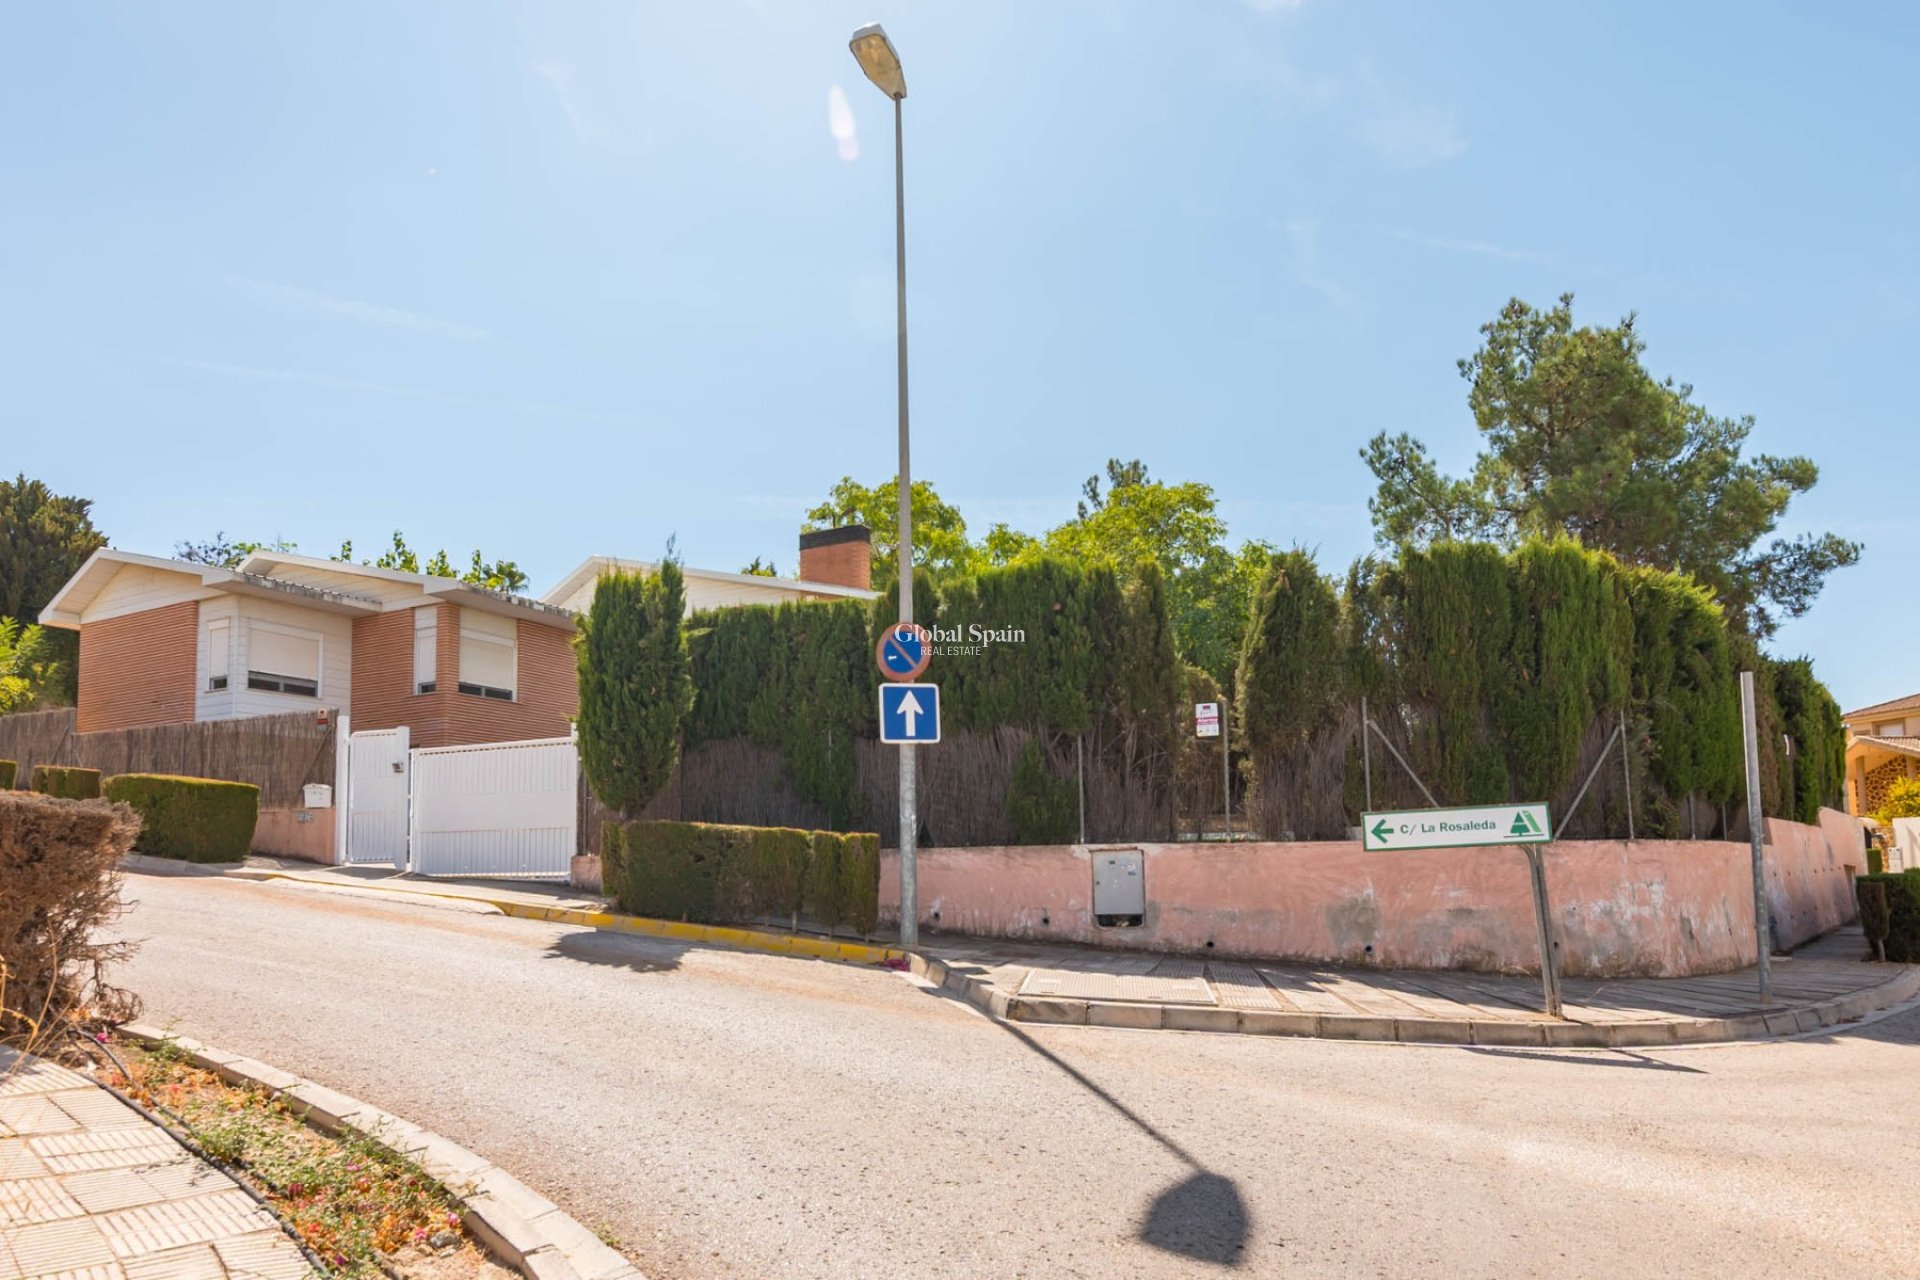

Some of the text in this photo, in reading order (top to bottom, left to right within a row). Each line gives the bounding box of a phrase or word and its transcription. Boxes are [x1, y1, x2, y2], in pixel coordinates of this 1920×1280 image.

[1400, 819, 1497, 836] C/ La Rosaleda
